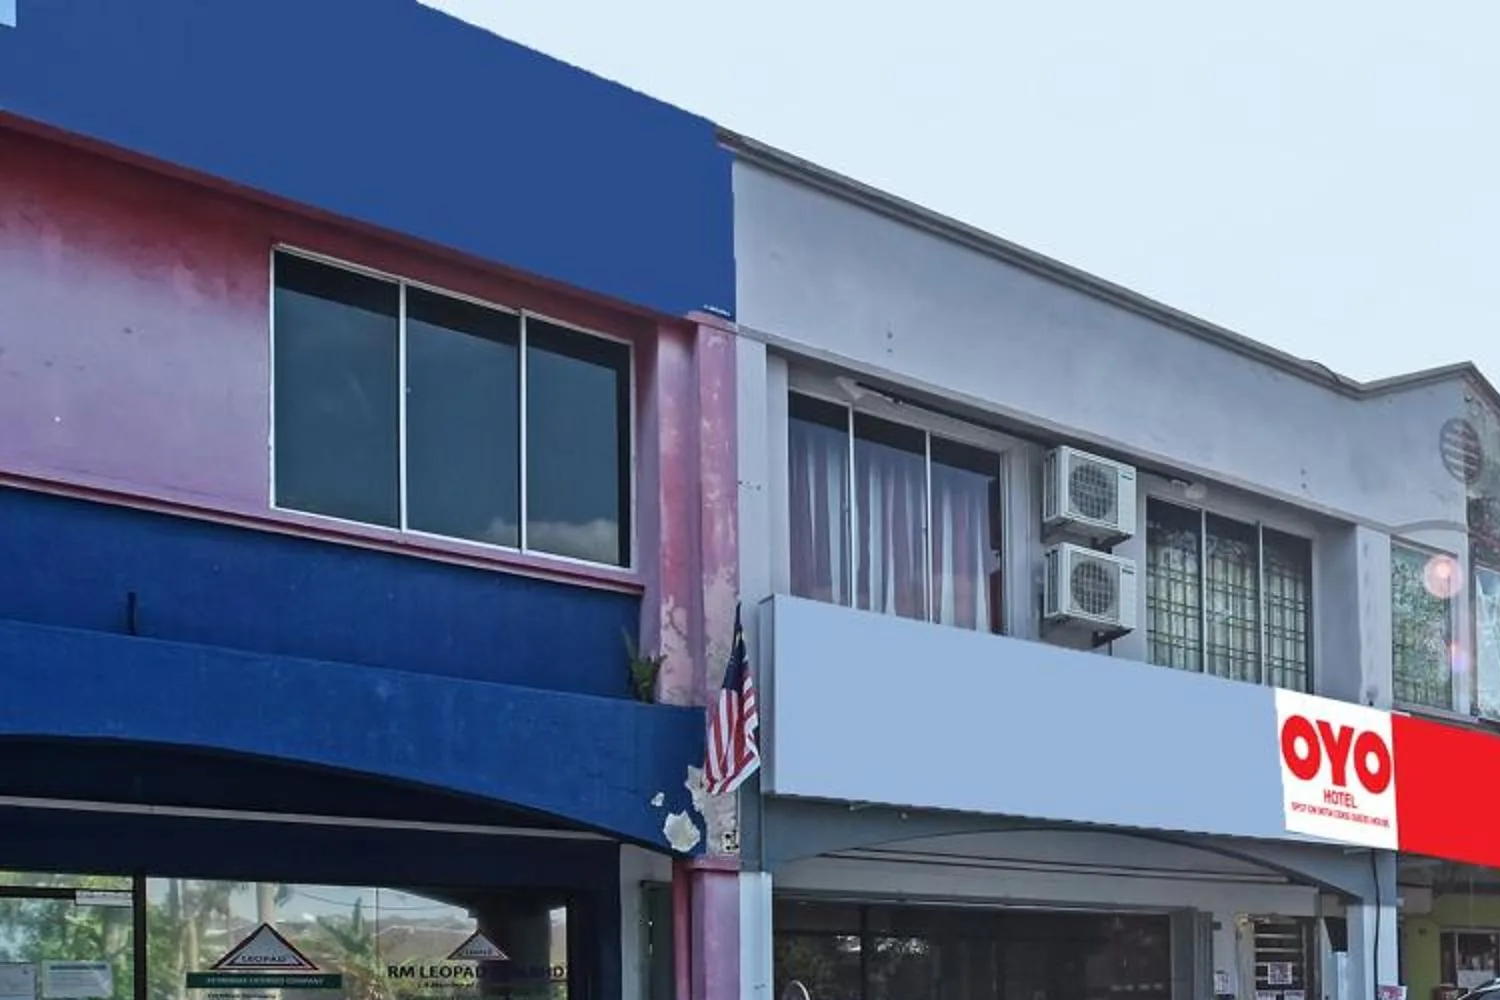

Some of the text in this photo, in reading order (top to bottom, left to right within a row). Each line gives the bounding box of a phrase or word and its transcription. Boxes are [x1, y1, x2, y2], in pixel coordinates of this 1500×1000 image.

[1281, 714, 1391, 794] OYO
[1323, 788, 1358, 809] HOTEL
[387, 965, 415, 979] RM
[420, 965, 487, 979] LEOPAD
